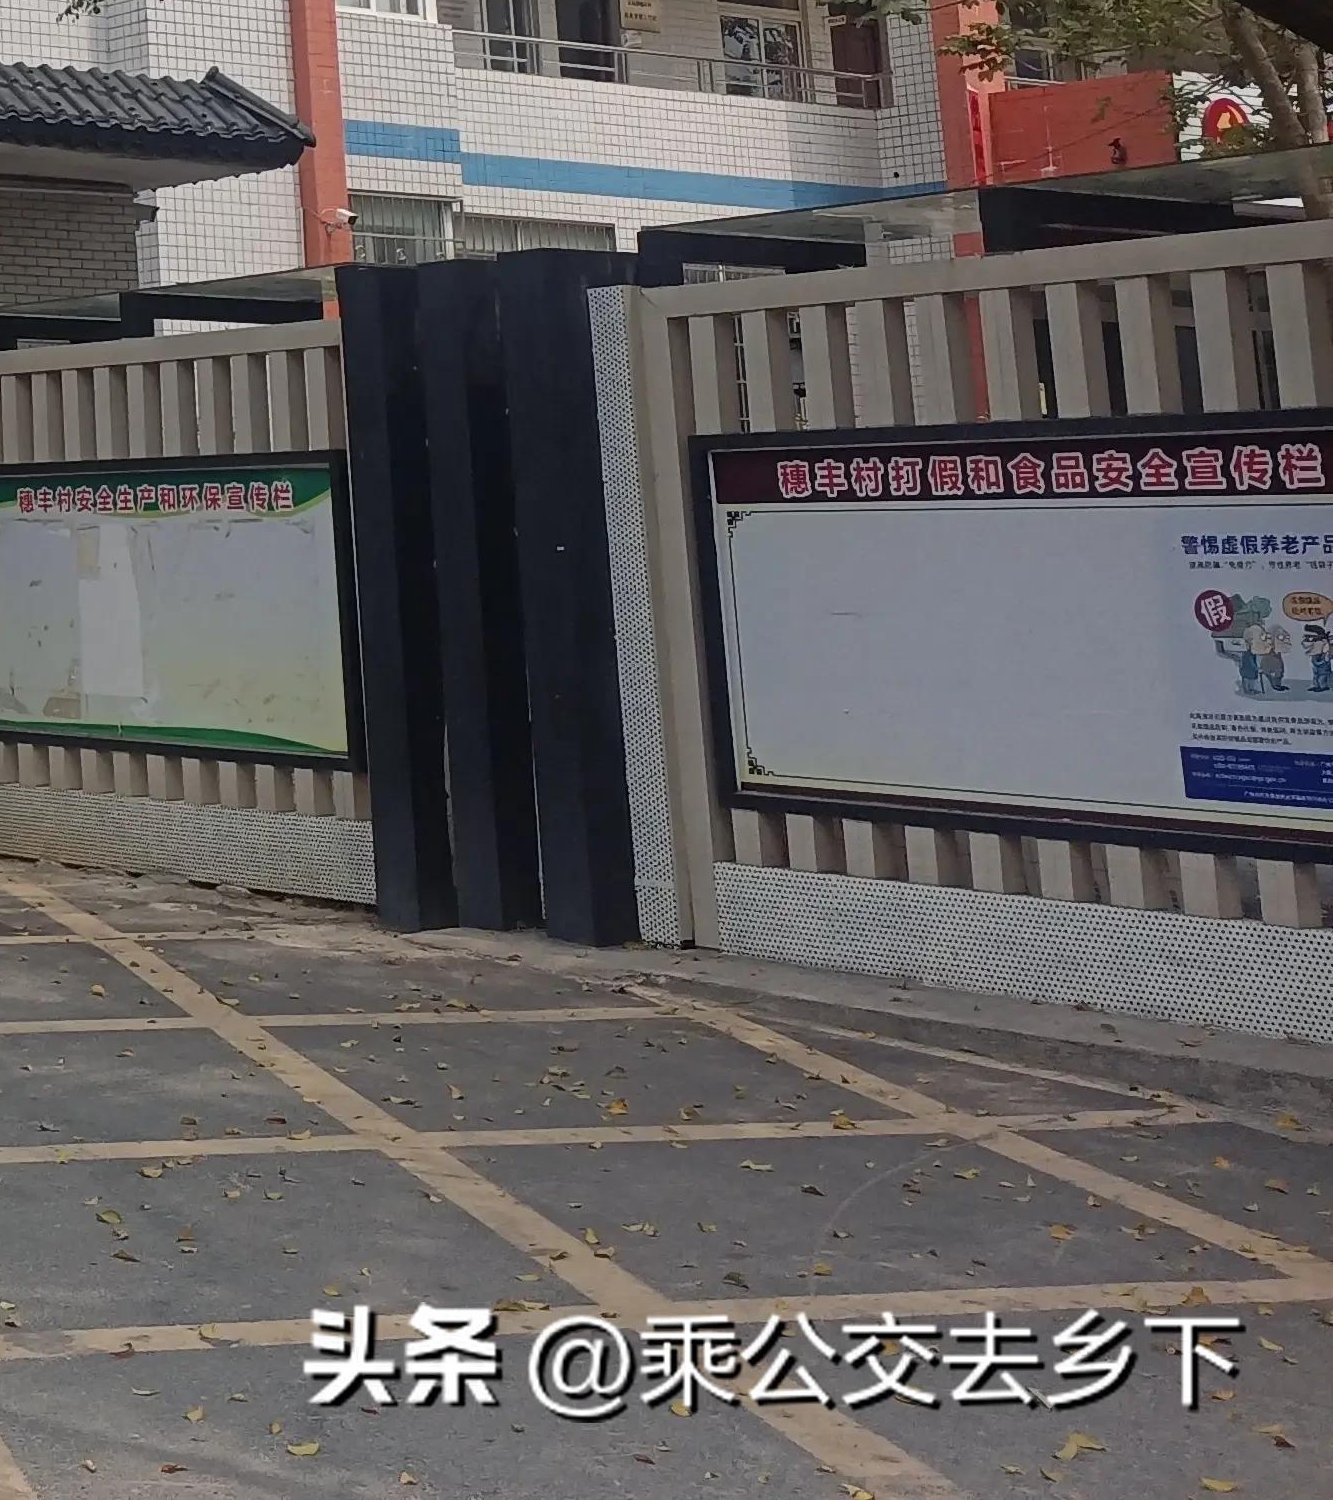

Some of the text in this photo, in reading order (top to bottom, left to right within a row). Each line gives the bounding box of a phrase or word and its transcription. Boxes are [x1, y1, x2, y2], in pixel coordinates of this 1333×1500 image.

[777, 444, 1325, 499] 穗丰村打假和食品安全宣传栏
[17, 481, 294, 514] 穗丰村安全生产和环保宣传栏
[1200, 594, 1231, 627] 假
